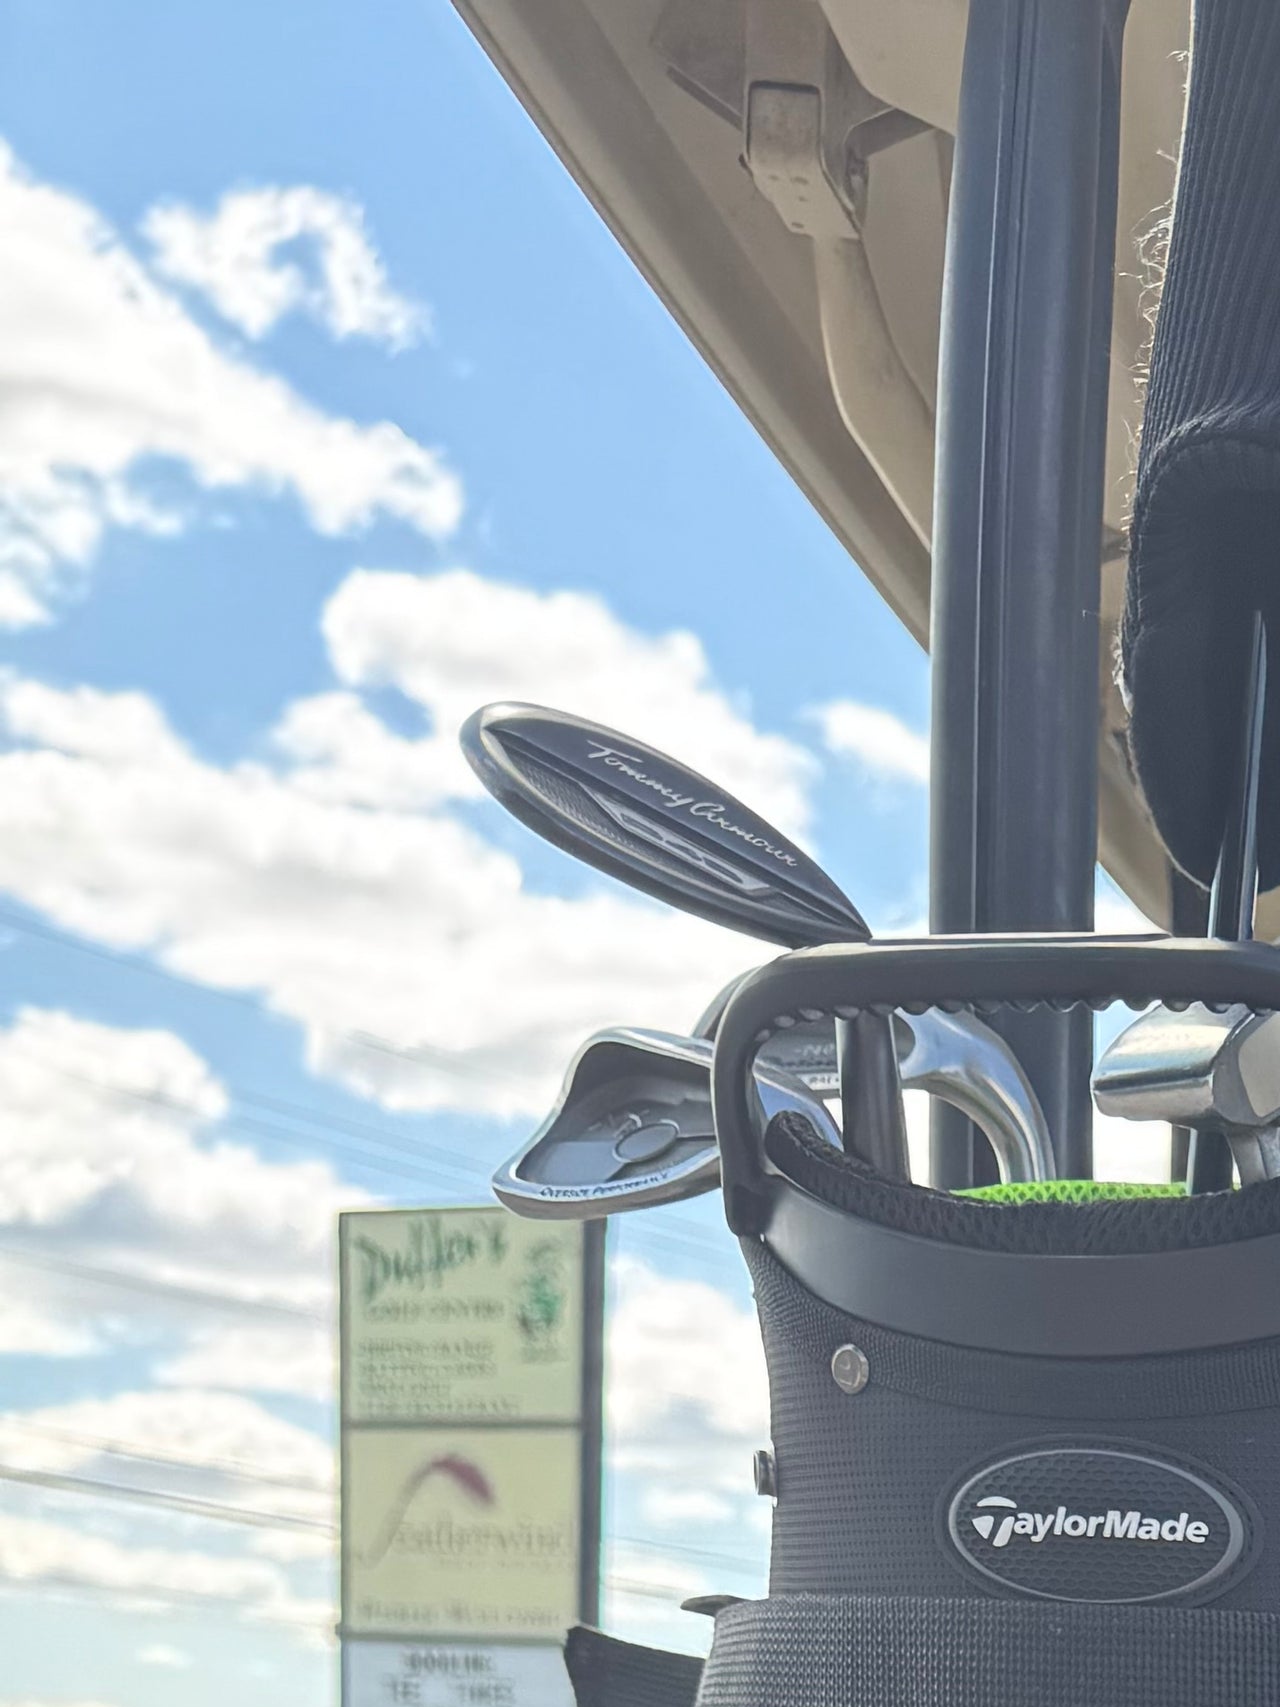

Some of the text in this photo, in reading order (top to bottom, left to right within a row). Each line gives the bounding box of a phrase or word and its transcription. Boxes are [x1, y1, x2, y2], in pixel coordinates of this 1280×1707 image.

[586, 739, 798, 867] Tommy Armour
[970, 1495, 1210, 1548] TaylorMade
